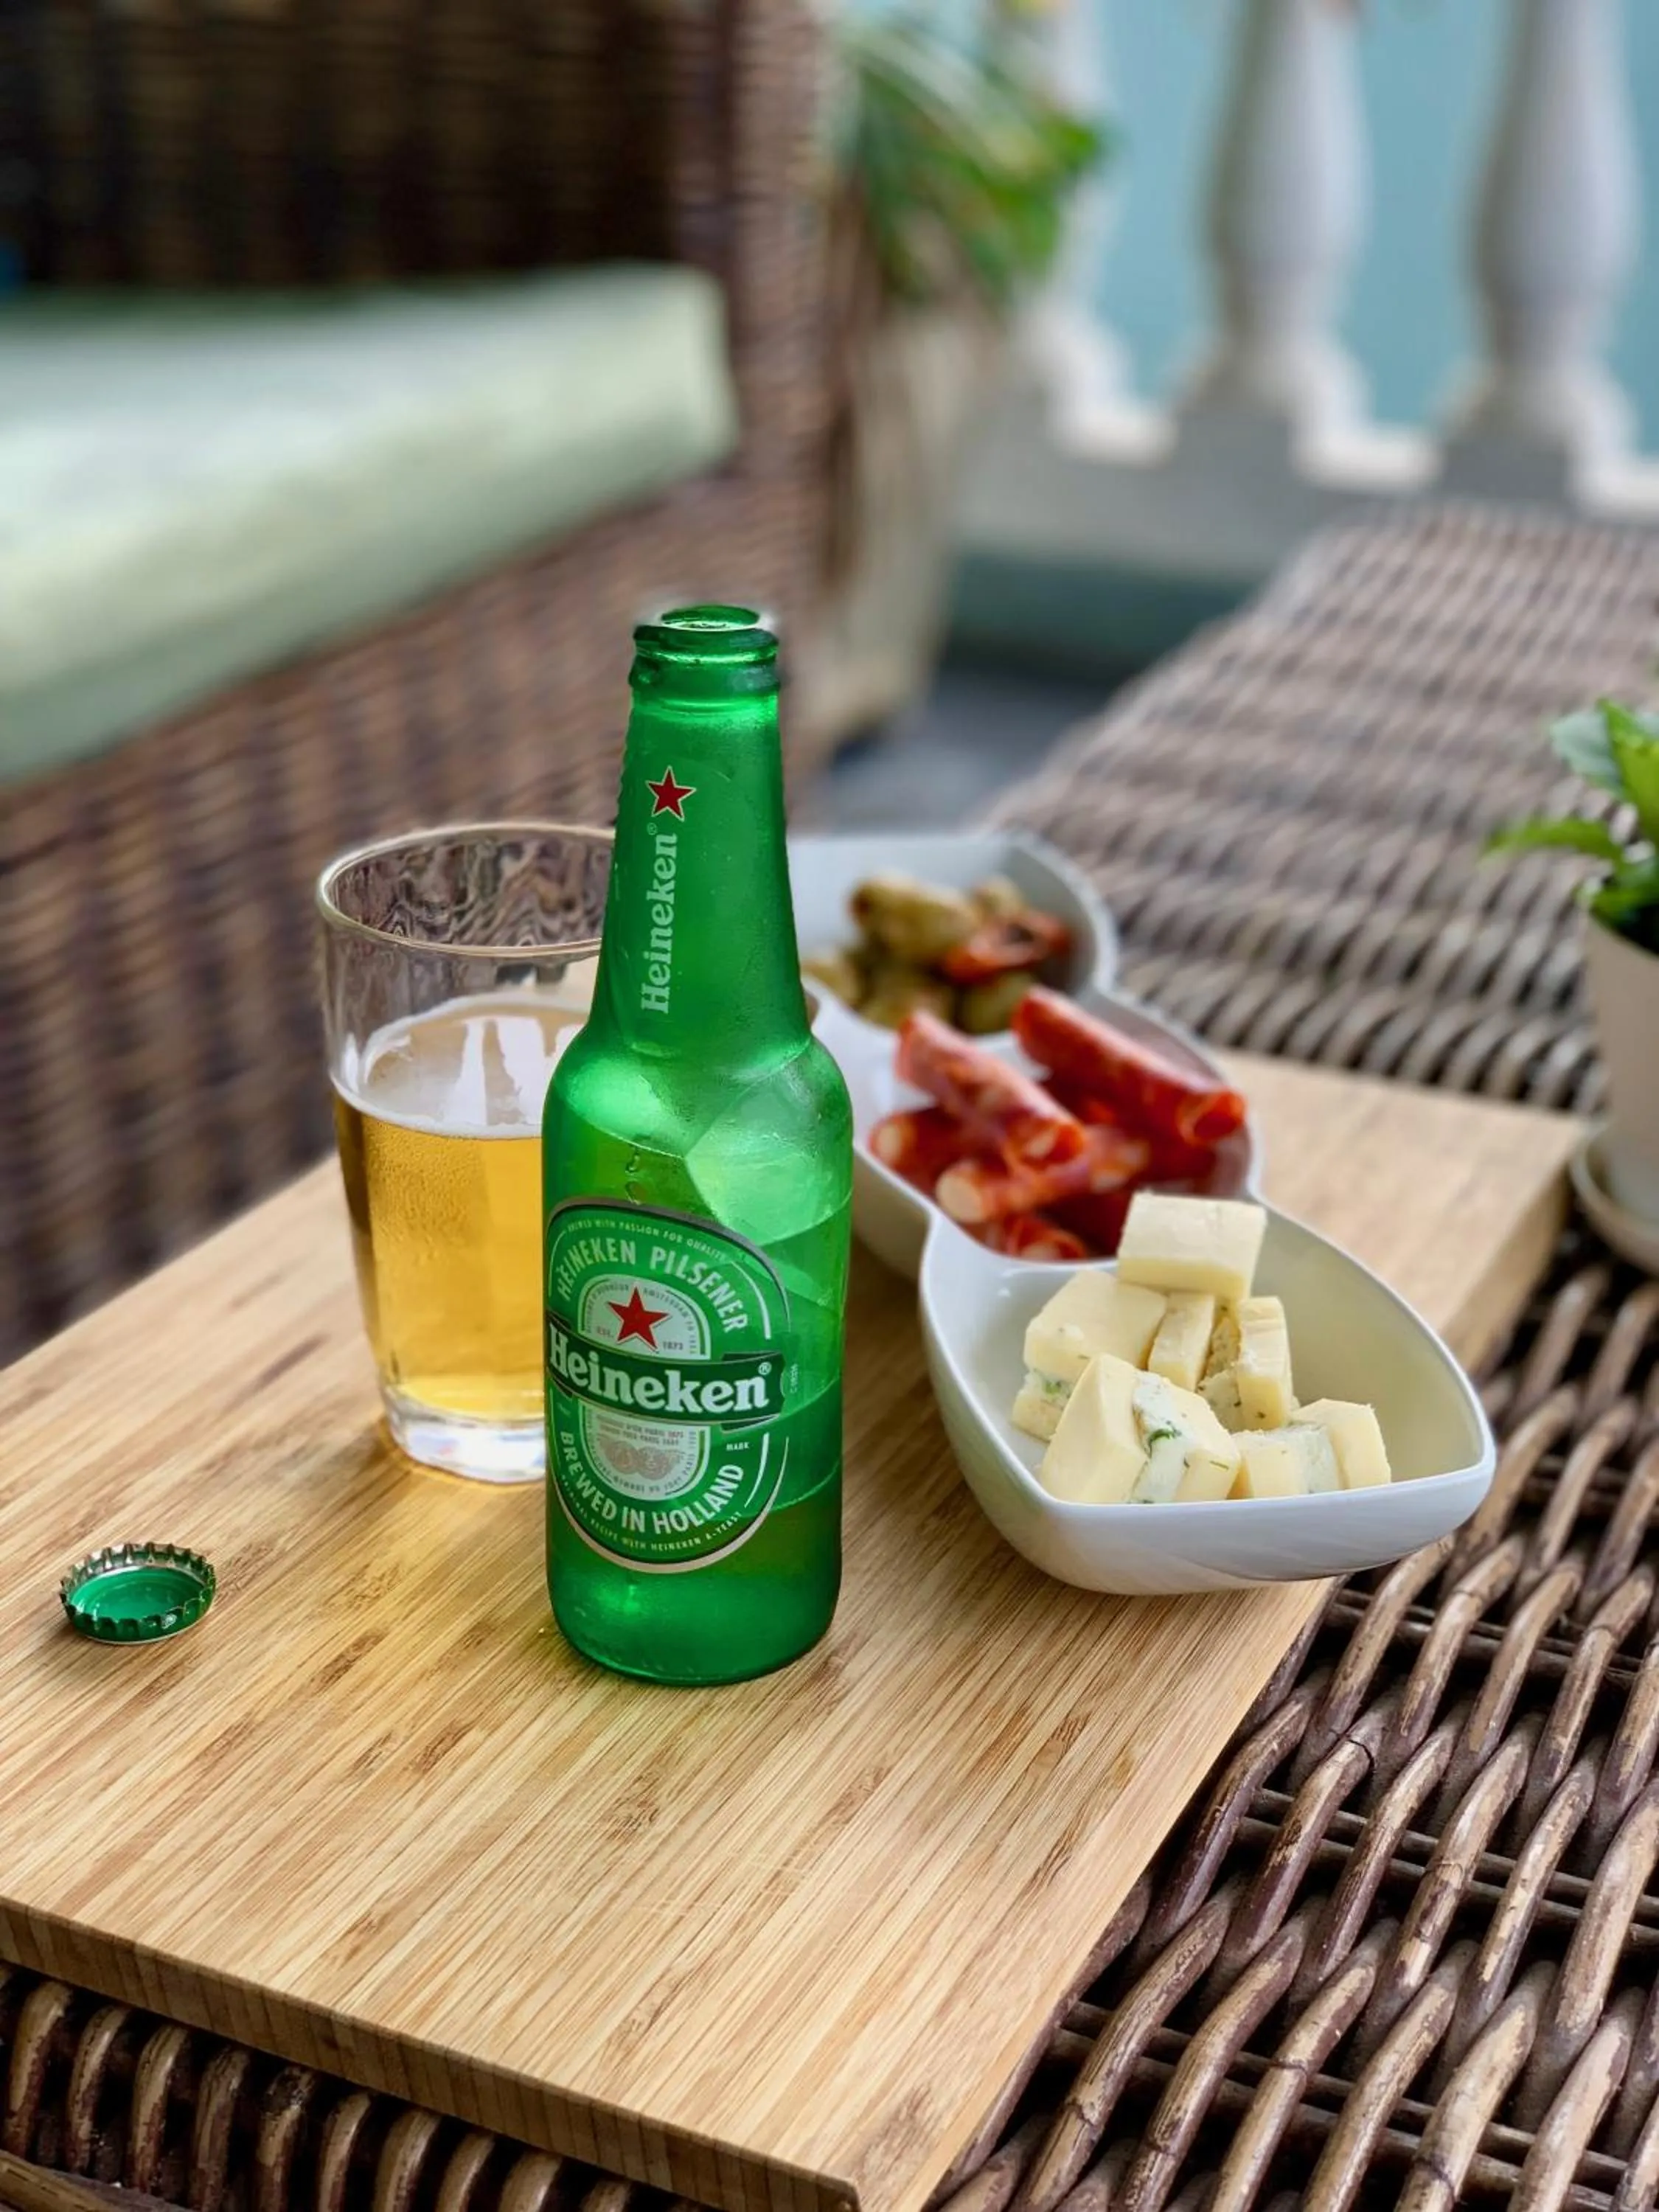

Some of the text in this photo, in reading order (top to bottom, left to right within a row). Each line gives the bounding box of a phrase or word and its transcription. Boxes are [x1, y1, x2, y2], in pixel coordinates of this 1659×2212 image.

[556, 1237, 636, 1301] HEINEKEN
[649, 1245, 748, 1333] PILSENER
[663, 1230, 682, 1244] FOR
[560, 1431, 617, 1520] BREWED
[621, 1506, 645, 1534] IN
[652, 1464, 744, 1534] HOLLAND
